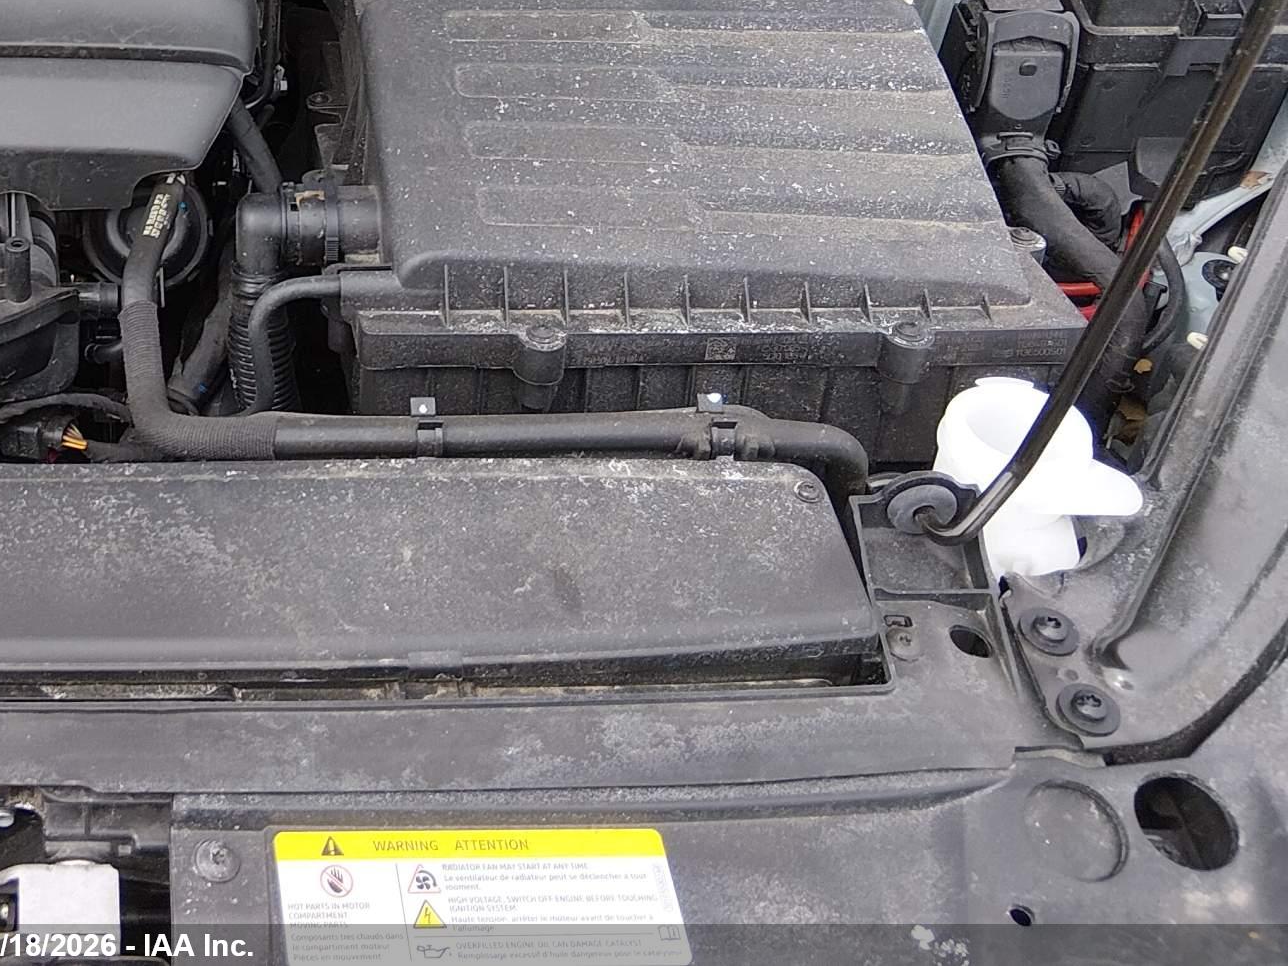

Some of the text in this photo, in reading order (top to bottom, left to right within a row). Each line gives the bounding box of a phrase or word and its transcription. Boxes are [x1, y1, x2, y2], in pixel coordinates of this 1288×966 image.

[373, 839, 529, 851] WARNING ATTENTION
[444, 874, 453, 882] Le
[455, 874, 499, 882] ventilateur
[549, 874, 568, 883] peut
[342, 902, 370, 910] MOTOR
[450, 905, 485, 913] IGNITION
[290, 921, 348, 929] MOVING PARTS
[290, 933, 338, 943] Composants
[384, 932, 403, 940] dans
[300, 943, 359, 953] compartiment
[360, 943, 390, 951] moteur
